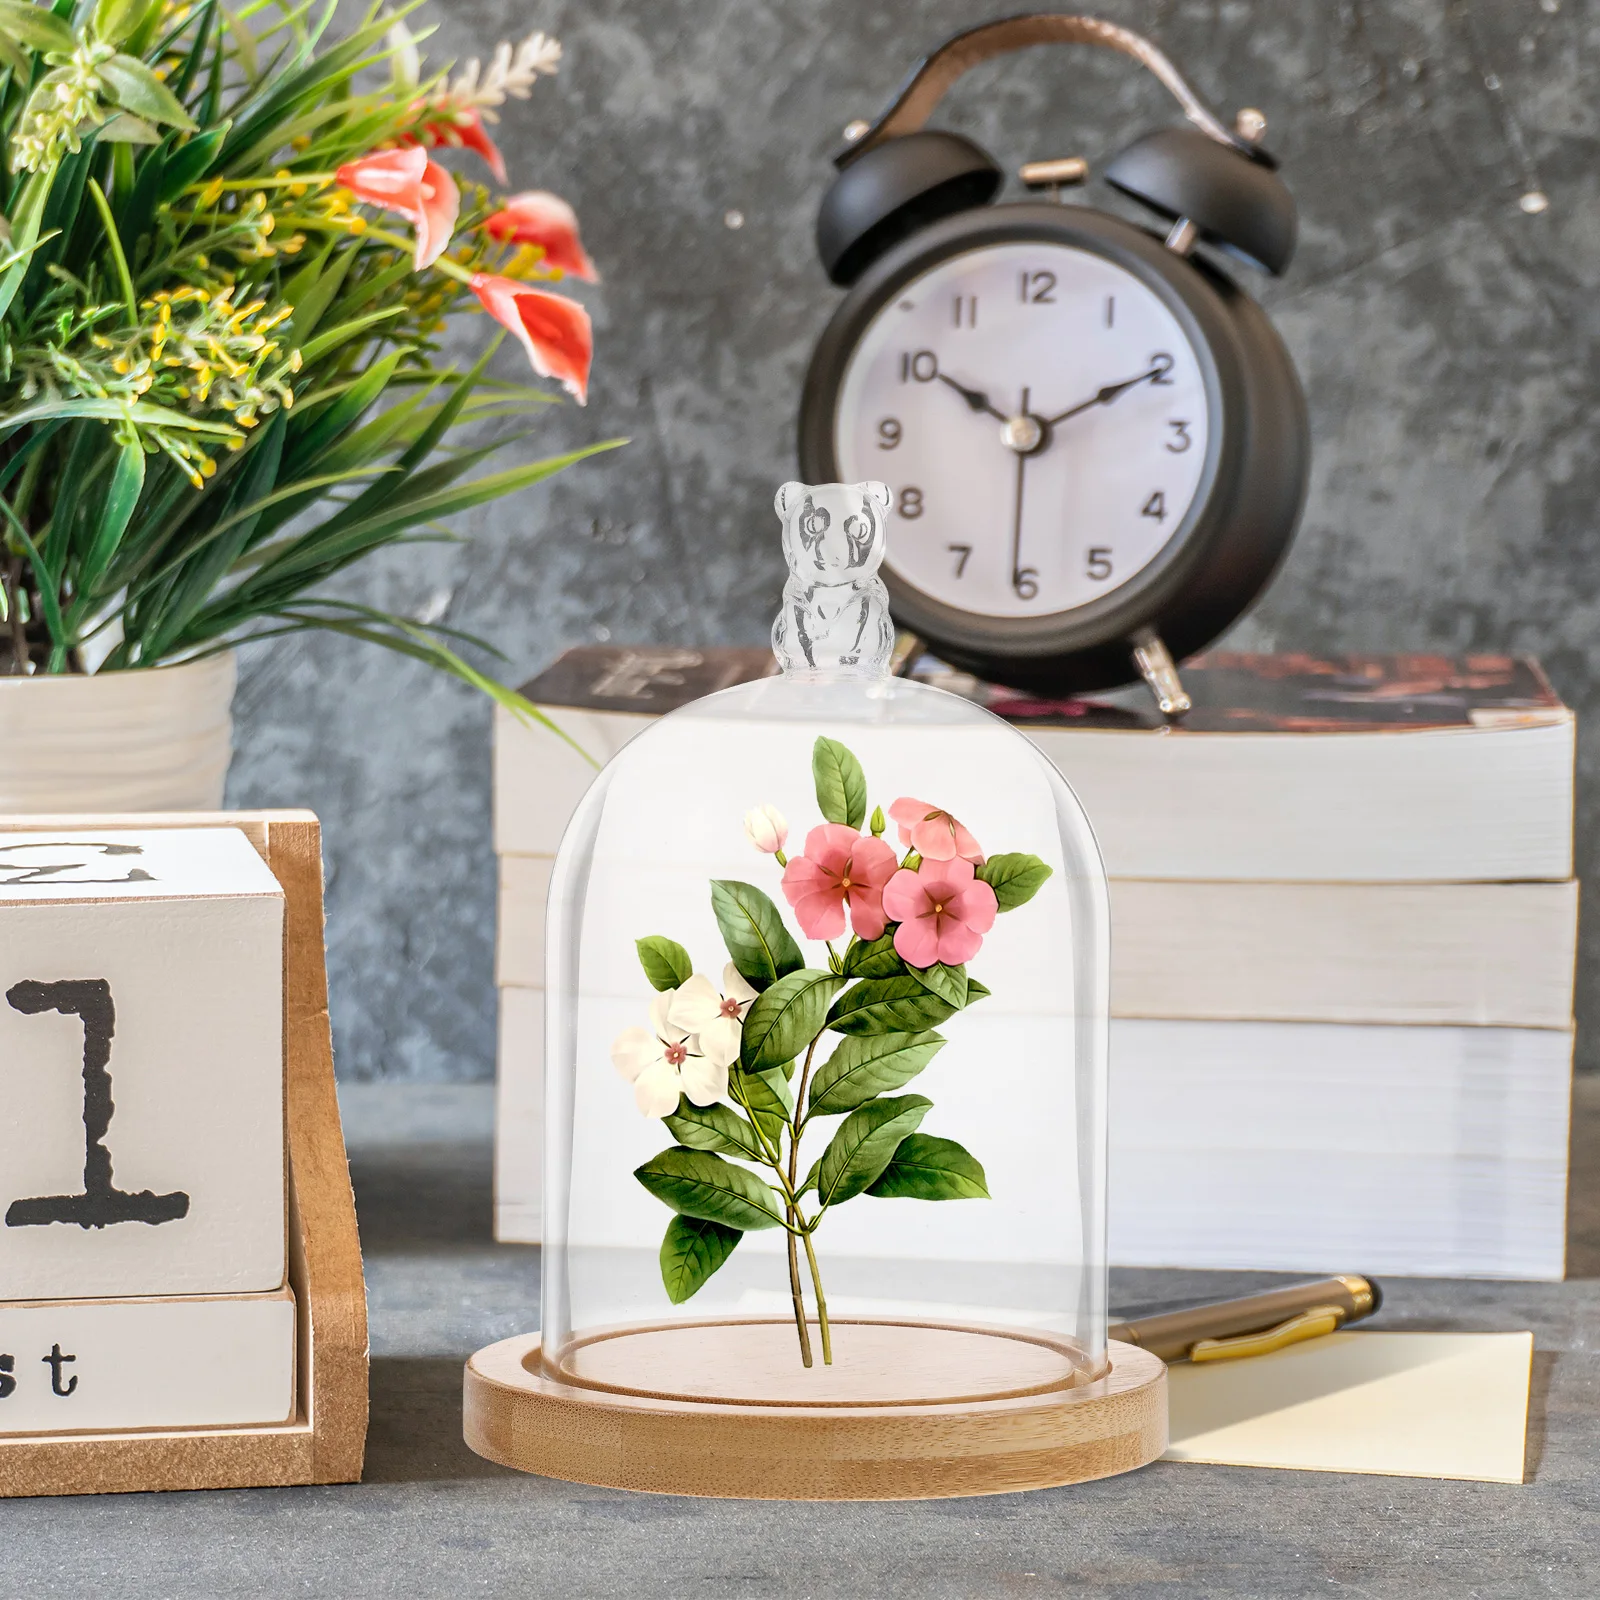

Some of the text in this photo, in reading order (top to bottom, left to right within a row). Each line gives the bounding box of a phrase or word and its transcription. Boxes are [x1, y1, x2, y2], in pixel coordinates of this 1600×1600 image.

[1021, 270, 1057, 304] 12
[953, 295, 978, 329] 11
[1104, 295, 1116, 329] 1
[900, 350, 938, 384] 10
[1150, 352, 1174, 386] 2
[878, 417, 903, 451] 9
[1166, 420, 1192, 454] 3
[897, 486, 924, 521] 8
[1141, 491, 1167, 523] 4
[947, 544, 973, 579] 7
[1086, 547, 1113, 581] 5
[1013, 567, 1040, 601] 6
